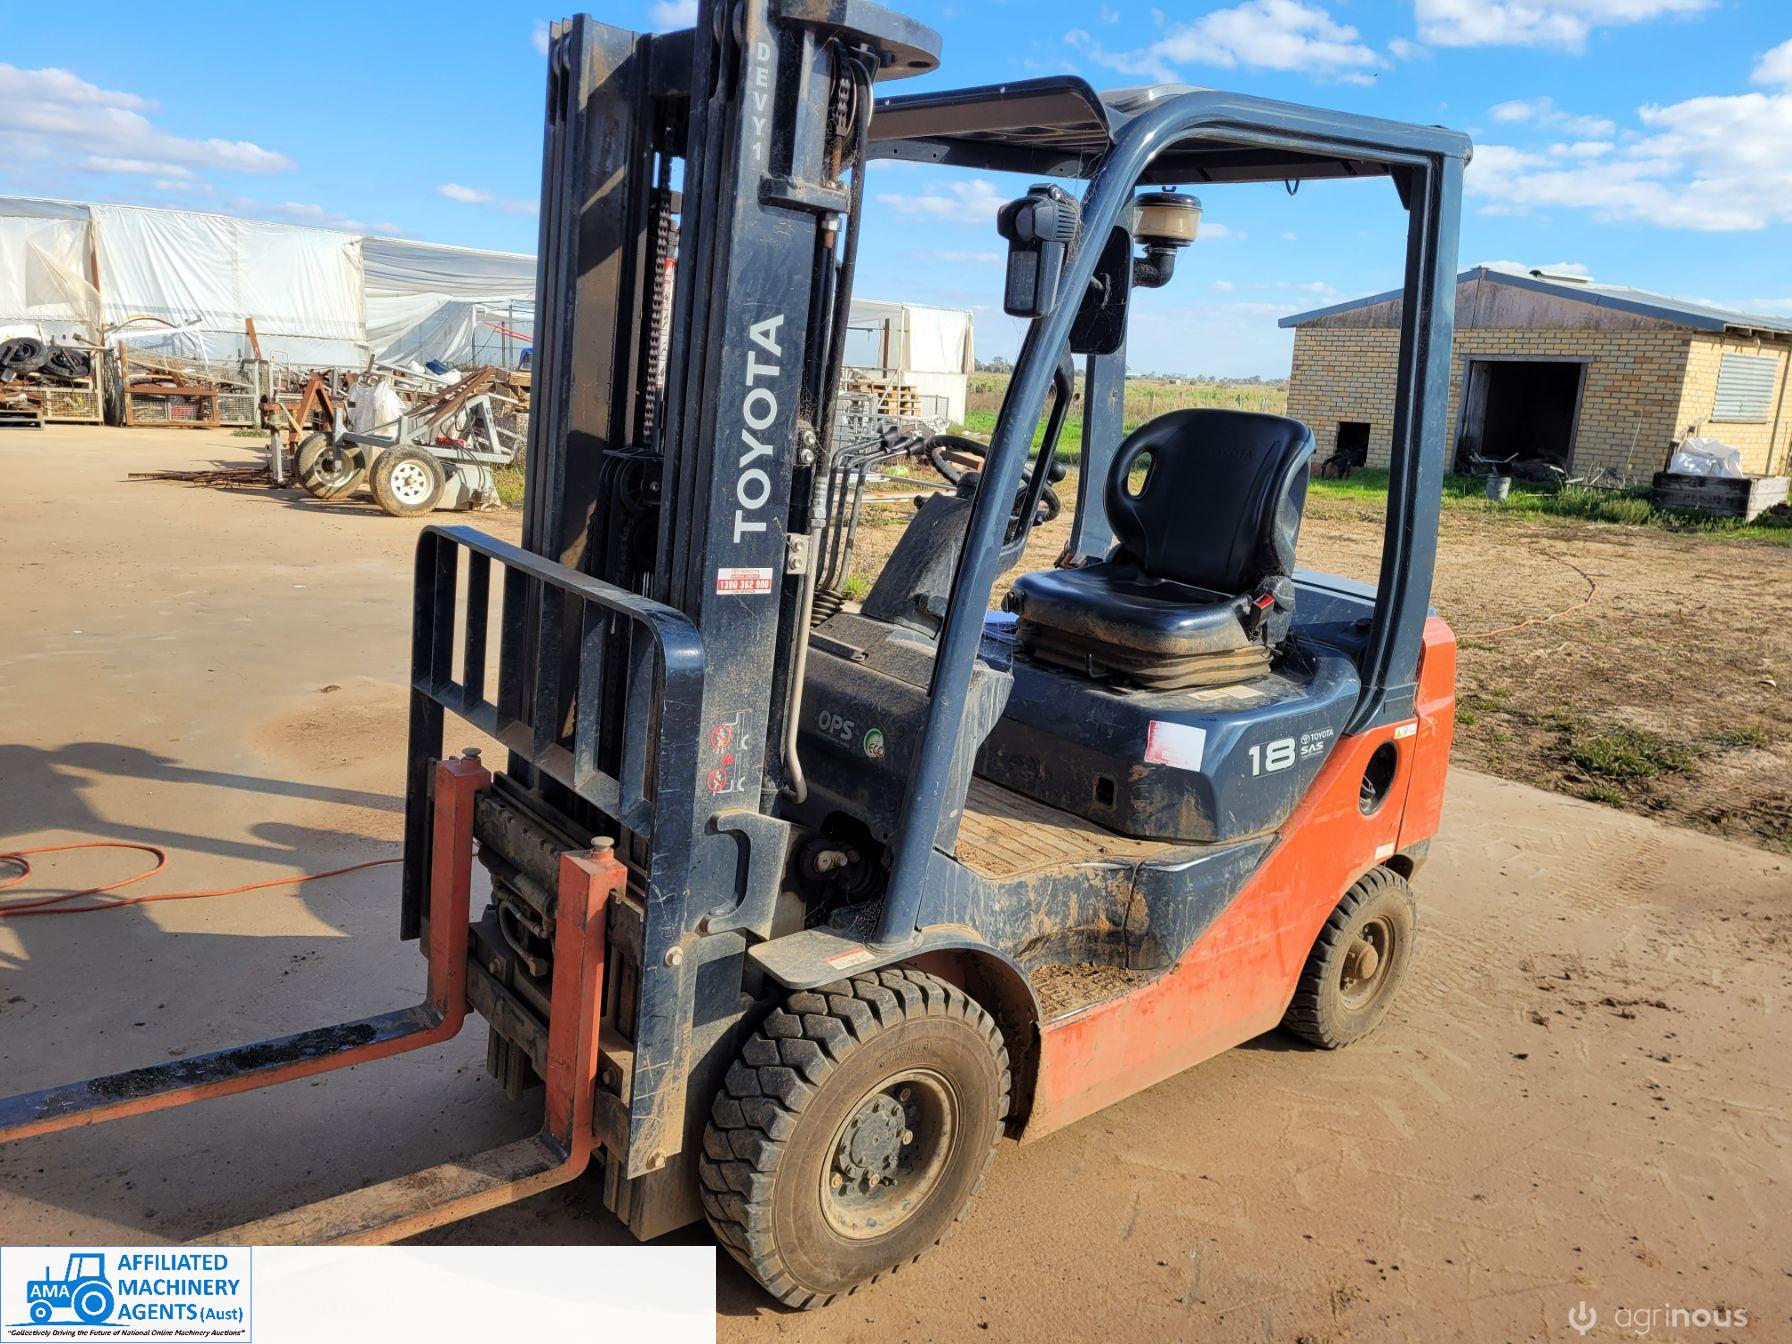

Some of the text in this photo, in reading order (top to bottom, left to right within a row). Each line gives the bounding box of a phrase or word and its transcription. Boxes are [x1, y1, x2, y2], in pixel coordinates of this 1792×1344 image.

[752, 42, 771, 161] DEVY1
[733, 314, 785, 543] TOYOTA
[740, 579, 754, 589] 362
[818, 710, 855, 740] OPS
[1310, 728, 1334, 742] TOYOTA
[1248, 738, 1296, 777] 18
[1300, 741, 1324, 756] SAS
